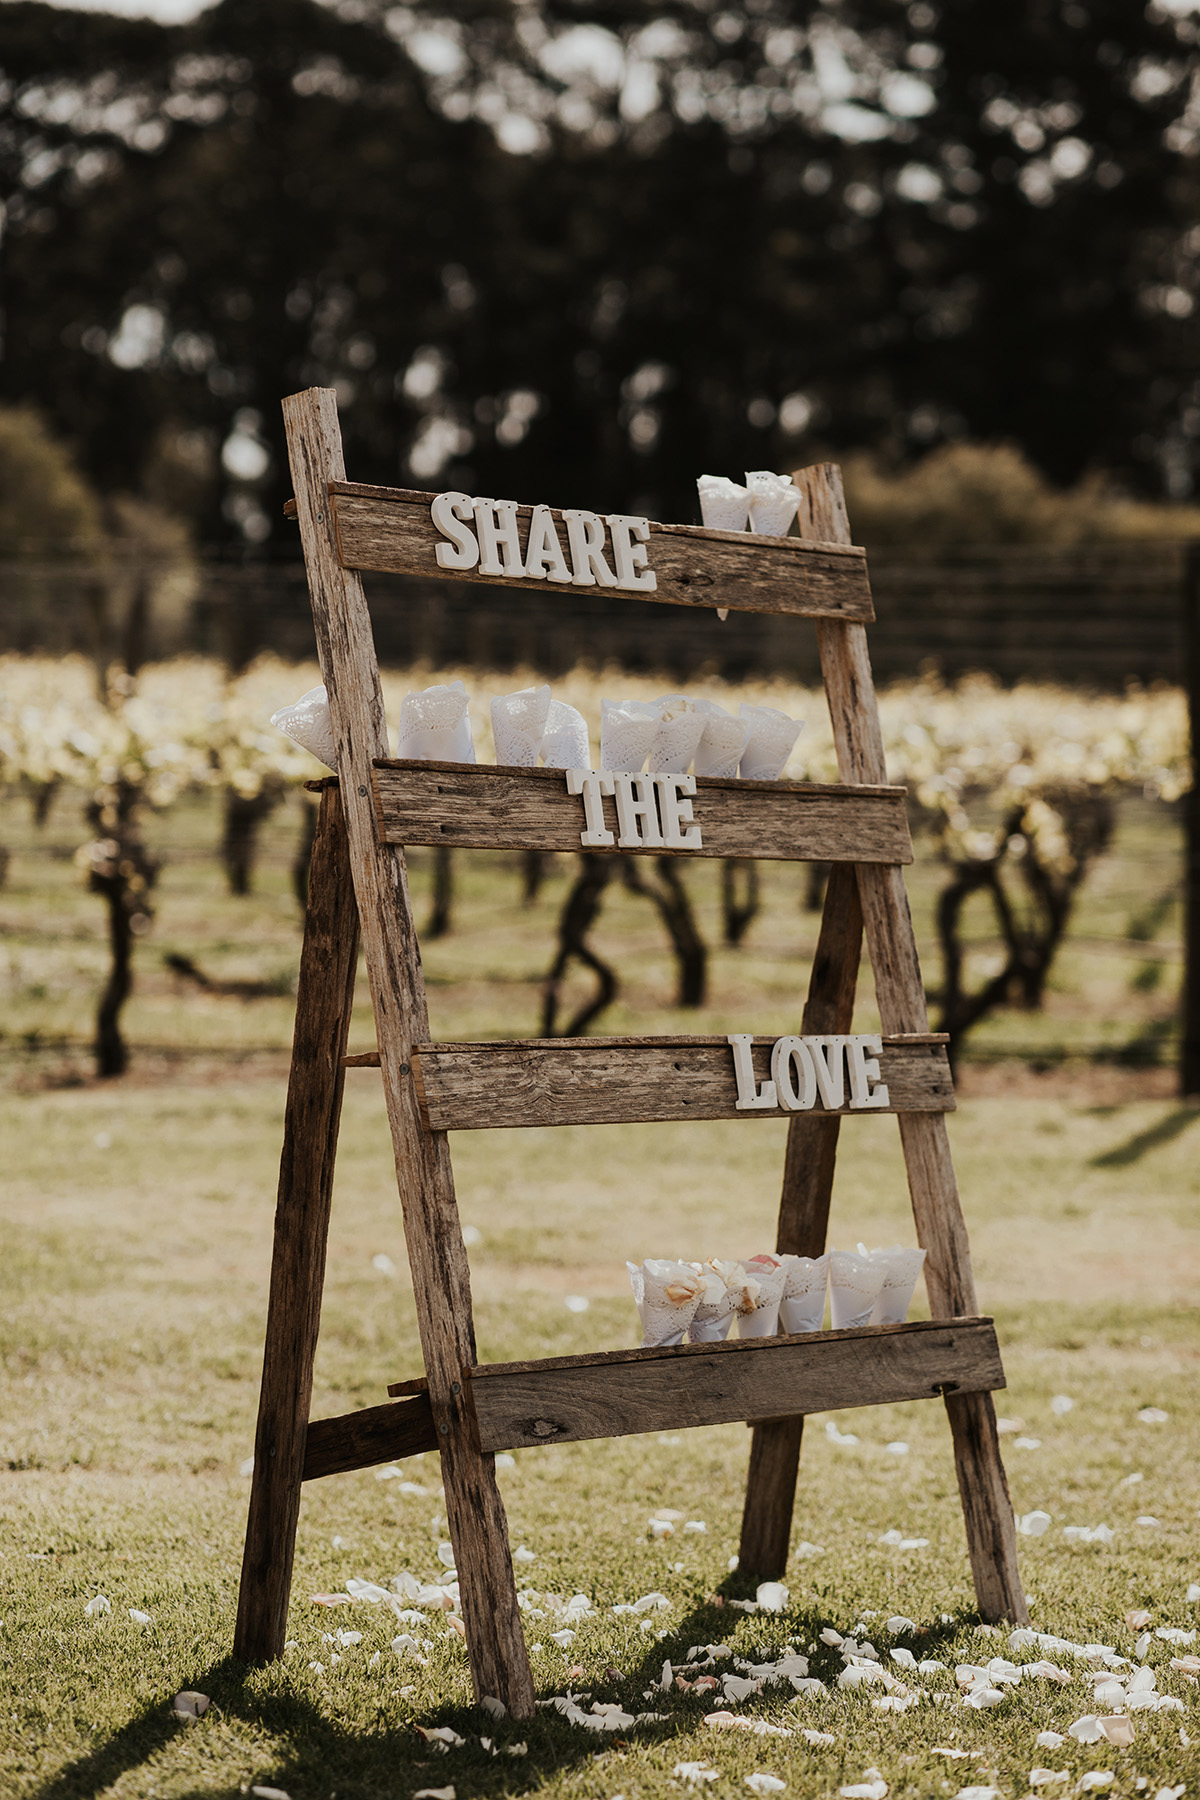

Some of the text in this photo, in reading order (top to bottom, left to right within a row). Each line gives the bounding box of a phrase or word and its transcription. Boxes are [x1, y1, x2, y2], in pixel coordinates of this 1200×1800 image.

[431, 491, 657, 592] SHARE
[566, 769, 702, 849] THE
[727, 1034, 890, 1111] LOVE
